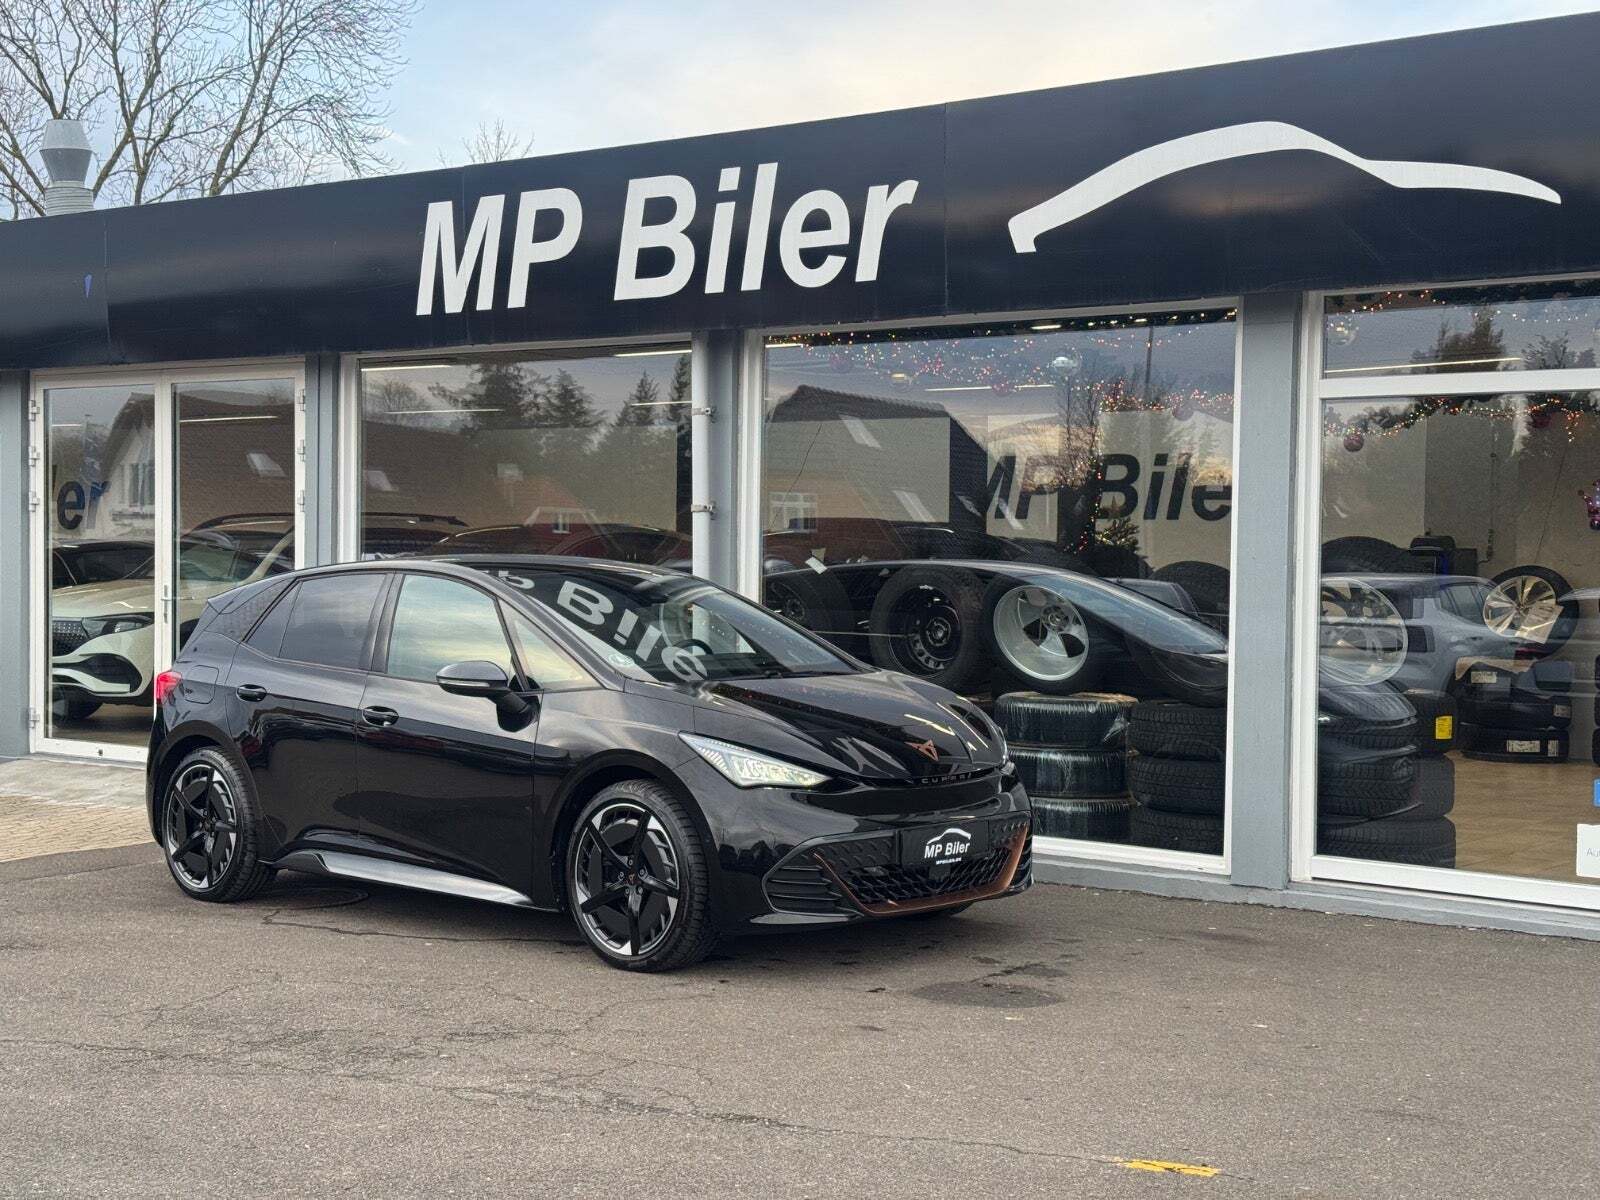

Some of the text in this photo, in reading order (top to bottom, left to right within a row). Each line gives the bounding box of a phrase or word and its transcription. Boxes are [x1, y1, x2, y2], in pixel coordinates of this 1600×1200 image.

[416, 162, 919, 315] MP Biler
[924, 841, 971, 858] MP Biler
